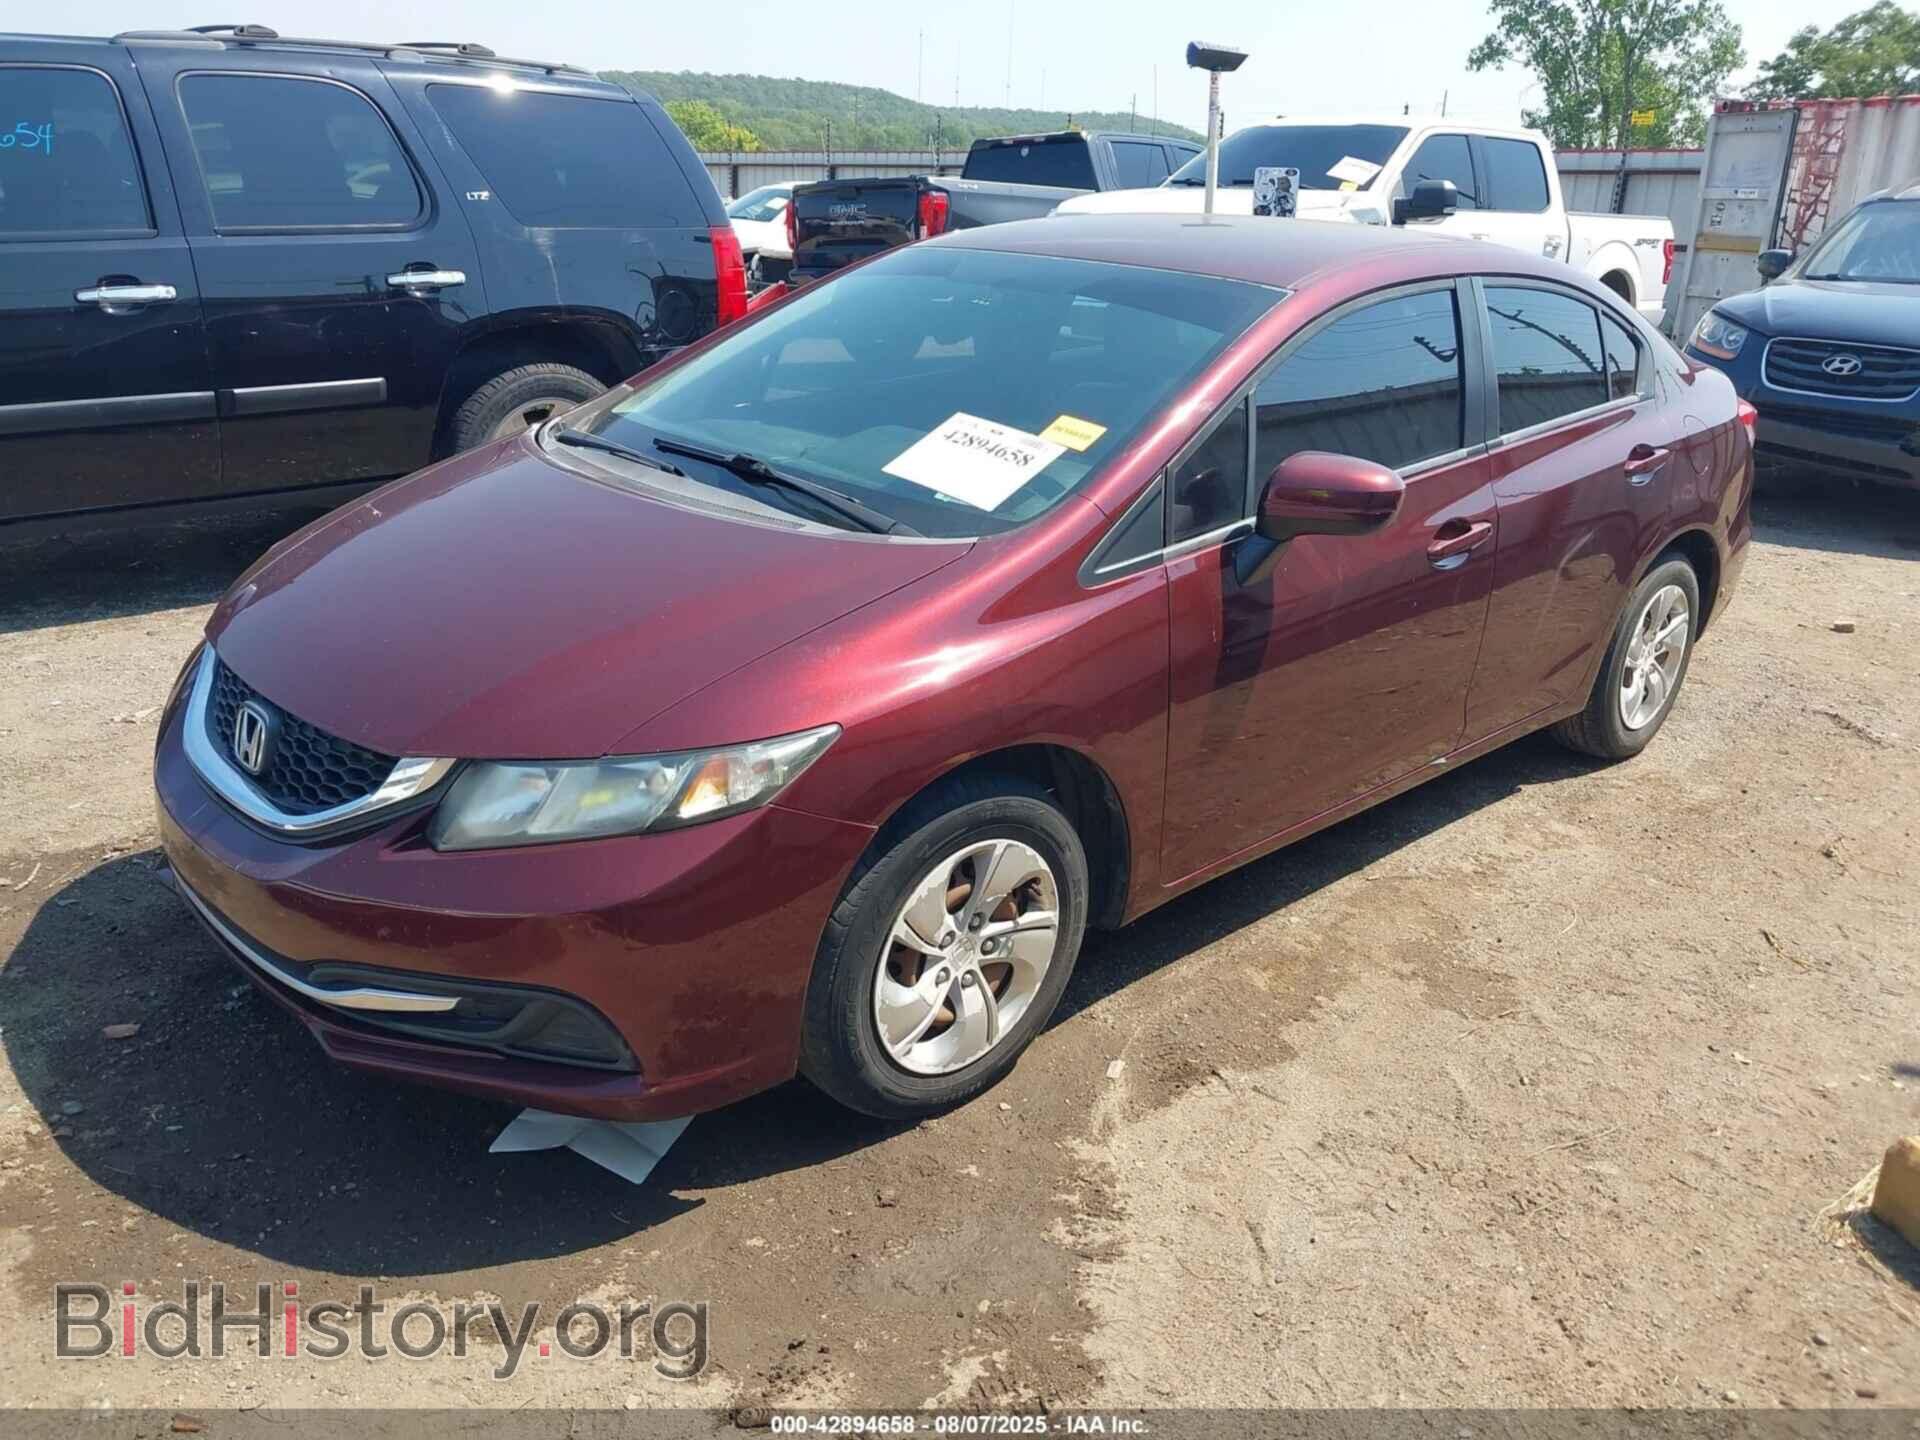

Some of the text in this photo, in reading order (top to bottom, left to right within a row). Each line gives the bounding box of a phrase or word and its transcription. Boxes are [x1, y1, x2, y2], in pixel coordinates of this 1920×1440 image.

[465, 190, 490, 201] LTZ
[829, 203, 867, 217] GMC
[943, 430, 1035, 466] 42894658
